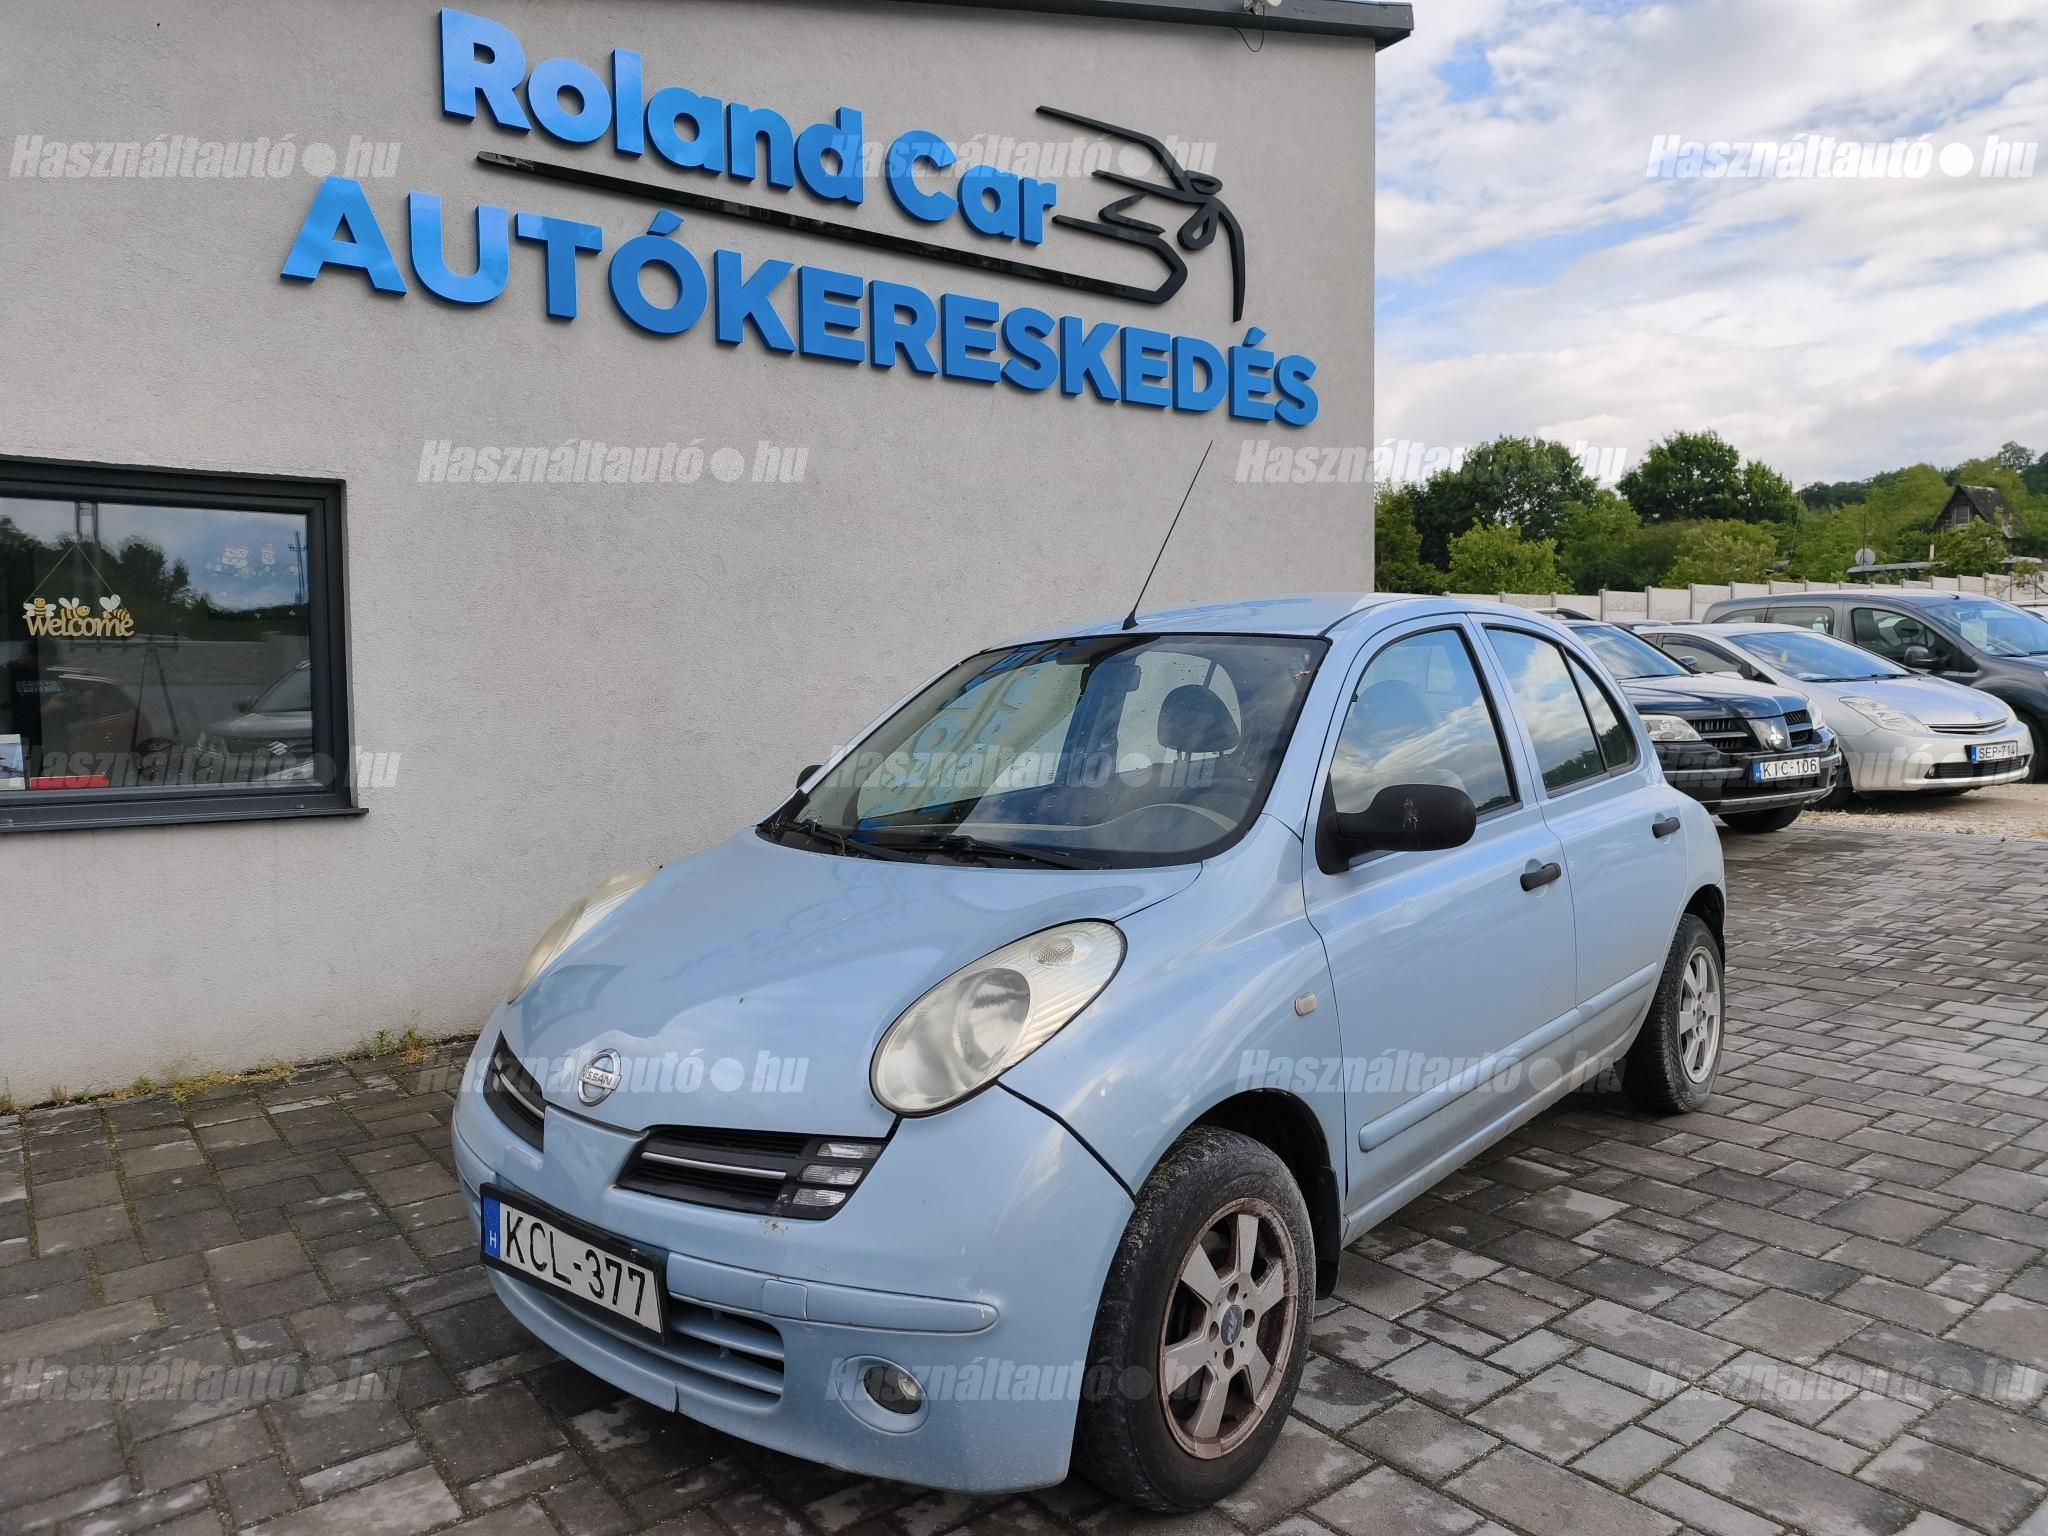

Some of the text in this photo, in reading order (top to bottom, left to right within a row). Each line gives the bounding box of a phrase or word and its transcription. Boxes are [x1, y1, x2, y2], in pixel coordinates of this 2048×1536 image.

[440, 7, 1057, 245] Roland Car
[280, 175, 1319, 427] AUTÓKERESKEDÉS
[26, 609, 135, 637] Welcome
[1763, 759, 1817, 777] KIC-106
[506, 1211, 646, 1316] KCL-377
